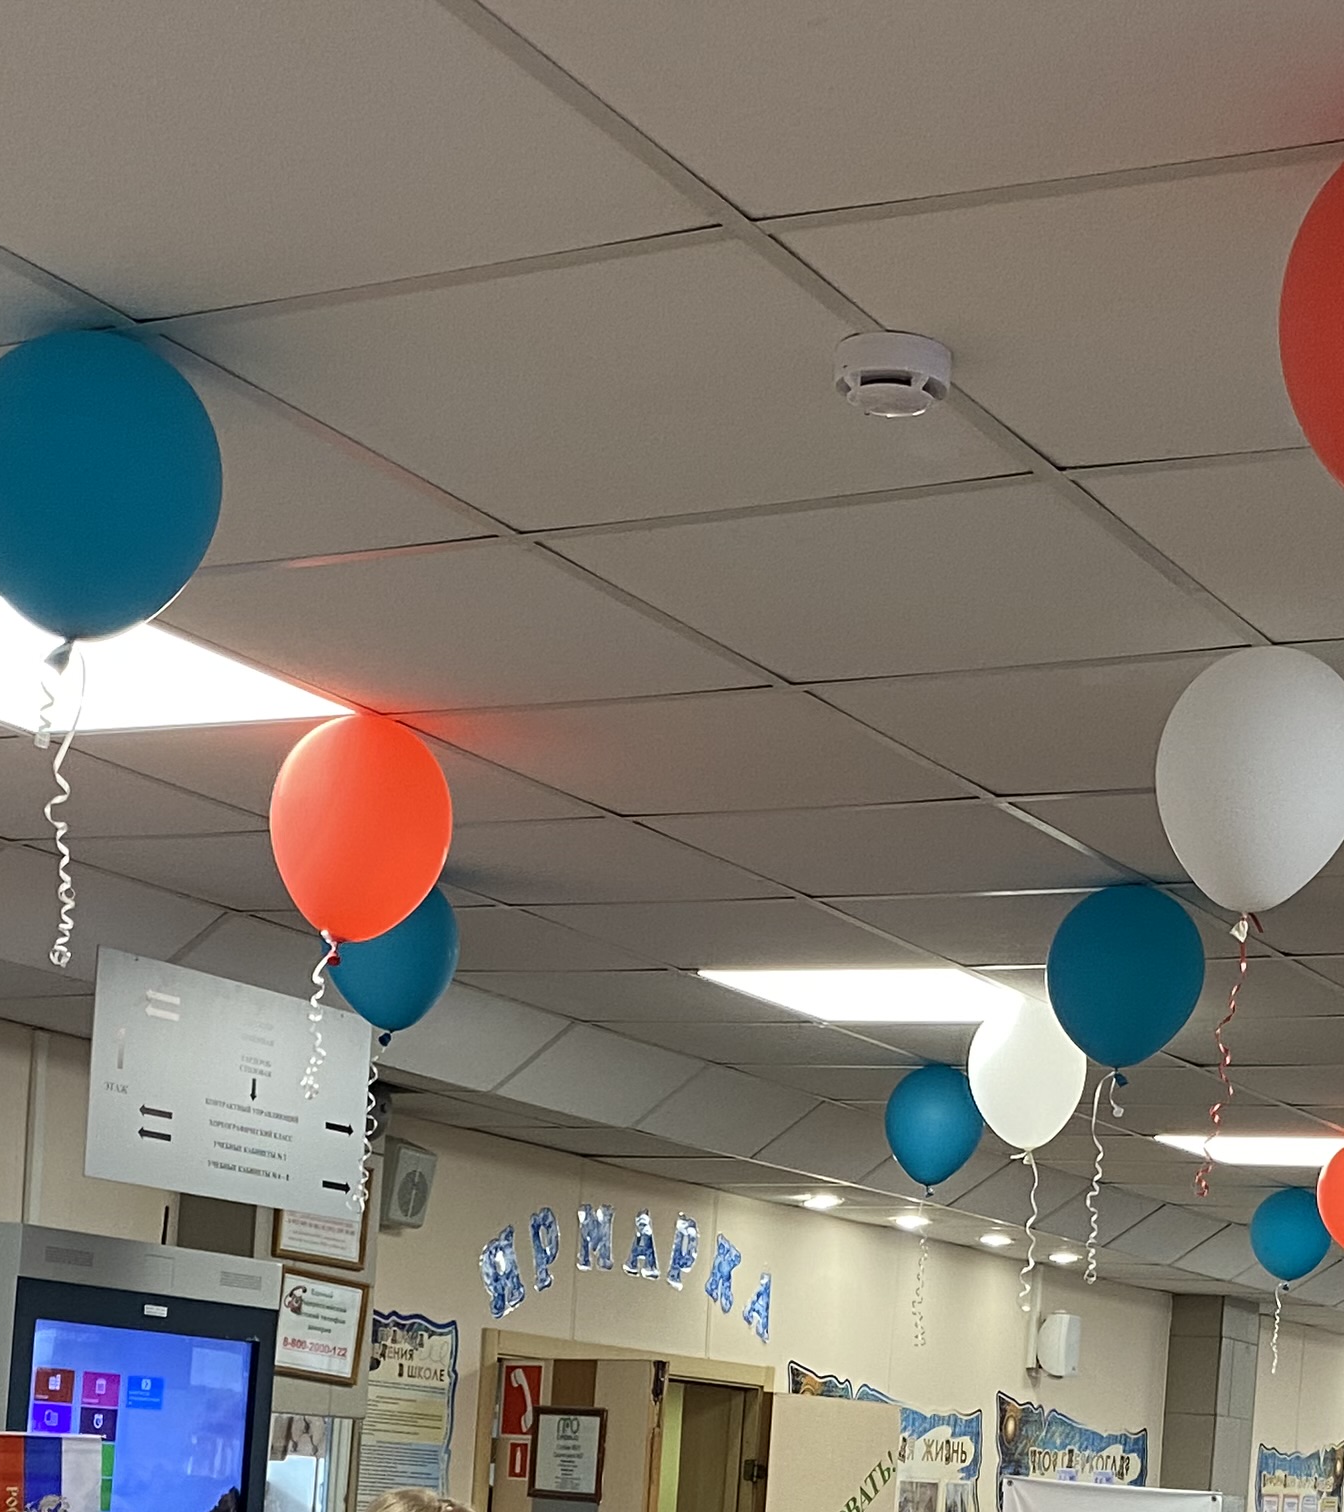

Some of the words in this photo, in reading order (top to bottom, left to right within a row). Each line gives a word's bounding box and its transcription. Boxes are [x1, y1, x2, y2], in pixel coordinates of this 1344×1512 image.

[478, 1203, 771, 1344] ЯРМАРКА
[282, 1336, 348, 1358] 8-800-2000-122
[407, 1365, 445, 1382] ШКОЛЕ
[921, 1438, 967, 1466] ЖИЗНЬ
